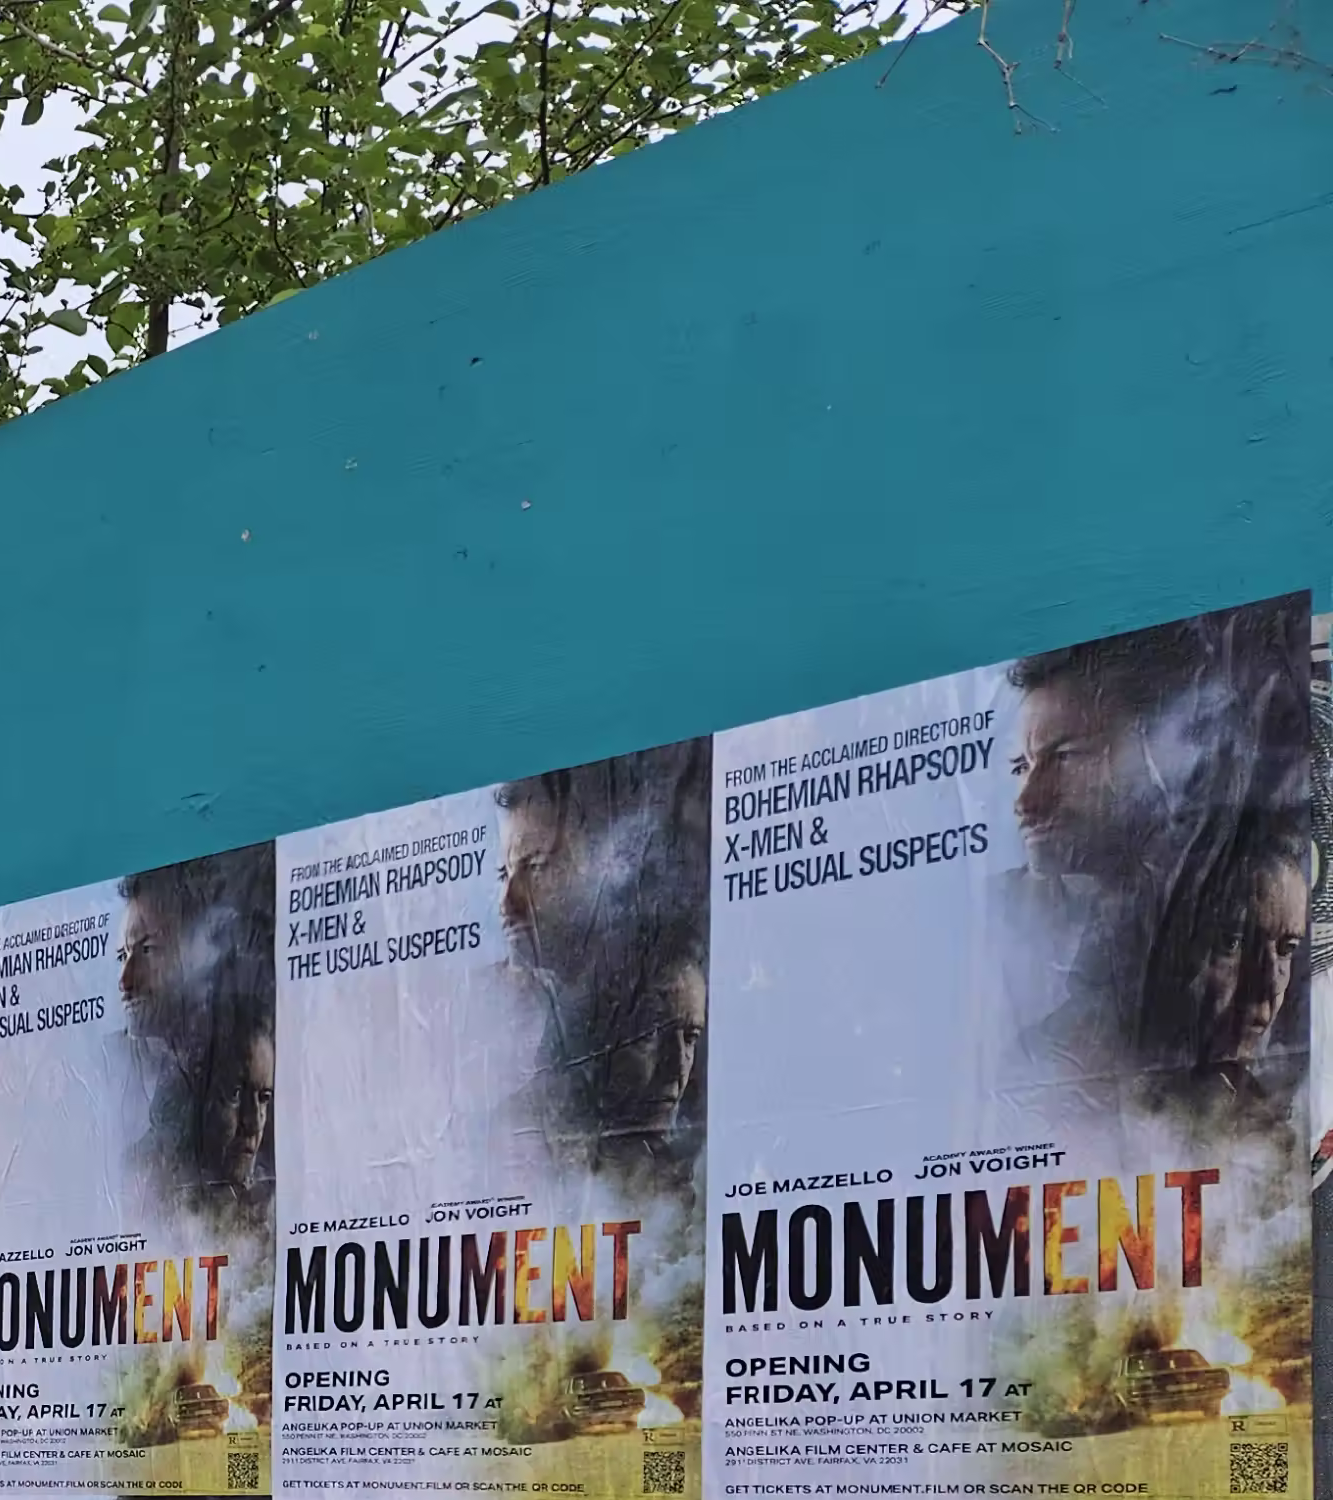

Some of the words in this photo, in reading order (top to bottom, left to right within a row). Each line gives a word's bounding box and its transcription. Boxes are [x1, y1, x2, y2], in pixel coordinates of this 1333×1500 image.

[726, 769, 850, 825] BOHEMIAN
[857, 736, 995, 796] RHAPSODY
[725, 819, 803, 864] X-MEN
[809, 814, 827, 846] &
[290, 871, 381, 914] BOHEMIAN
[385, 848, 485, 895] RHAPSODY
[725, 866, 768, 903] THE
[774, 849, 852, 894] USUAL
[857, 821, 990, 877] SUSPECTS
[290, 912, 347, 947] X-MEN
[351, 908, 365, 936] &
[35, 932, 109, 971] RHAPSODY
[289, 951, 321, 981] THE
[325, 939, 382, 975] USUAL
[386, 920, 481, 964] SUSPECTS
[9, 983, 19, 1006] &
[35, 995, 107, 1031] SUSPECTS
[724, 1181, 766, 1200] JOE
[772, 1168, 893, 1195] MAZZELLO
[913, 1160, 967, 1181] JON
[972, 1150, 1066, 1175] VOIGHT
[721, 1164, 1220, 1316] MONUMENT
[284, 1217, 638, 1336] MONUMENT
[284, 1368, 390, 1389] OPENING
[724, 1351, 870, 1379] OPENING
[25, 1402, 81, 1420] APRIL
[85, 1401, 106, 1418] 17
[282, 1394, 367, 1415] FRIDAY,
[372, 1391, 445, 1411] APRIL
[451, 1390, 479, 1409] 17
[724, 1382, 839, 1409] FRIDAY,
[848, 1377, 948, 1402] APRIL
[958, 1375, 996, 1398] 17
